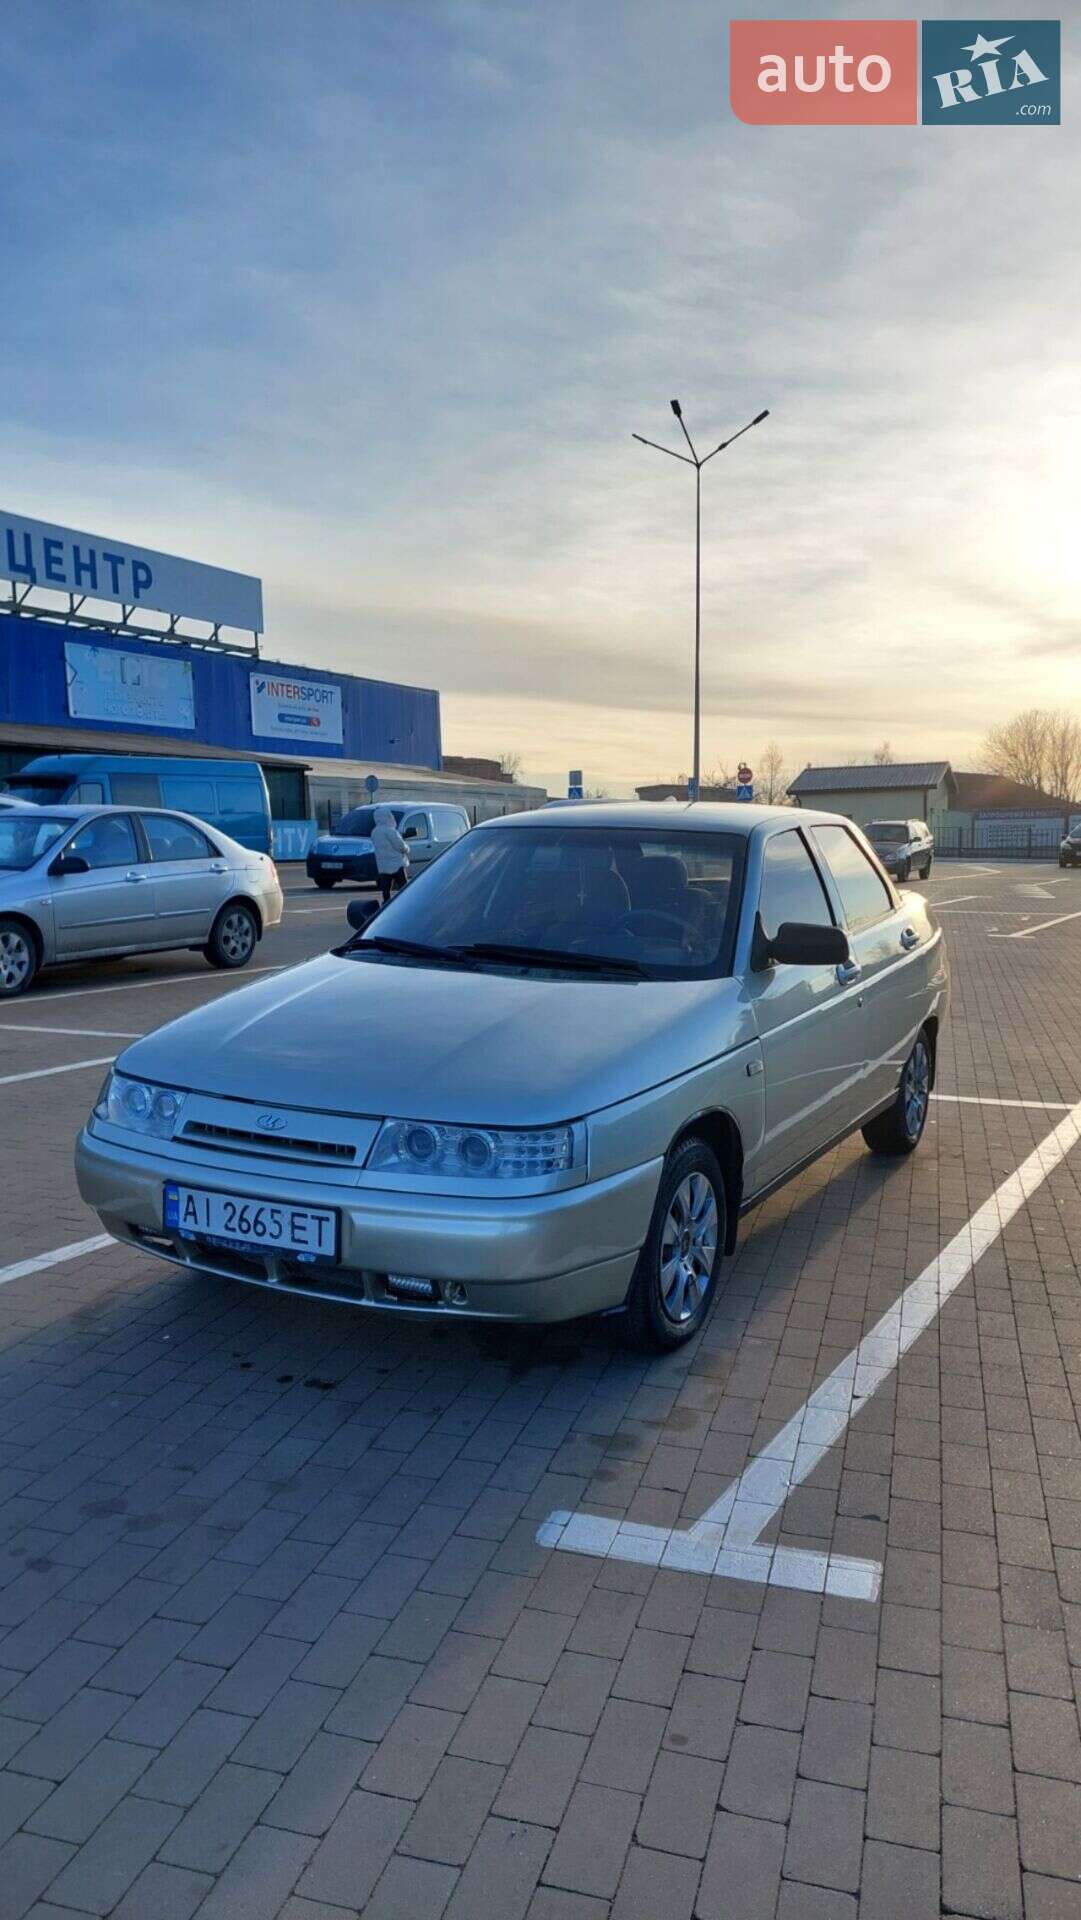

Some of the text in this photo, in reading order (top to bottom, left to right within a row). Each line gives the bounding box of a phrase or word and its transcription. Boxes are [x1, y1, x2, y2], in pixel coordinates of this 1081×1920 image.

[6, 528, 154, 599] ЦЕНТР
[266, 681, 335, 705] INTERSPORT
[183, 1194, 210, 1227] AI
[223, 1201, 283, 1240] 2665
[290, 1211, 330, 1248] ET
